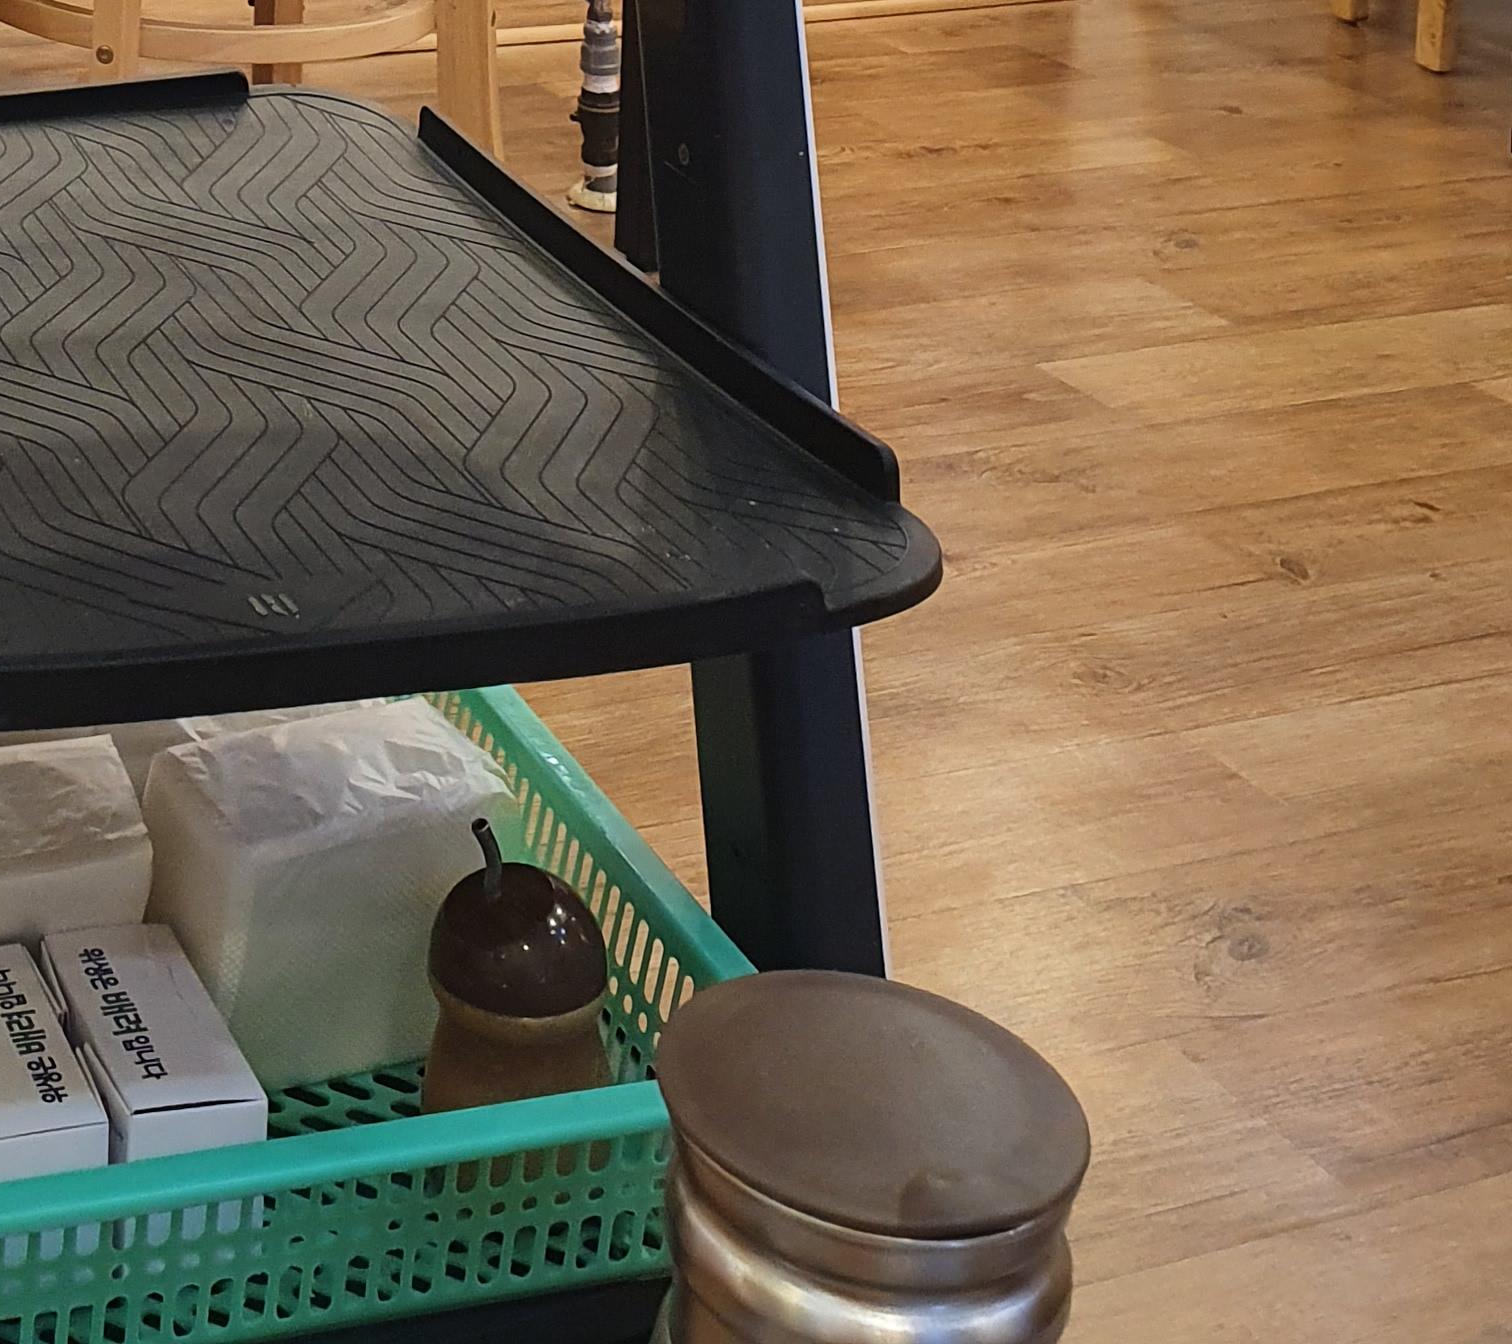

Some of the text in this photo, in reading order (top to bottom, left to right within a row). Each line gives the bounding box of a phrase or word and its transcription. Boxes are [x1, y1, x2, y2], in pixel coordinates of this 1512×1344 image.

[78, 947, 169, 1080] 위생은 배려입니다
[26, 1056, 69, 1103] 위생은
